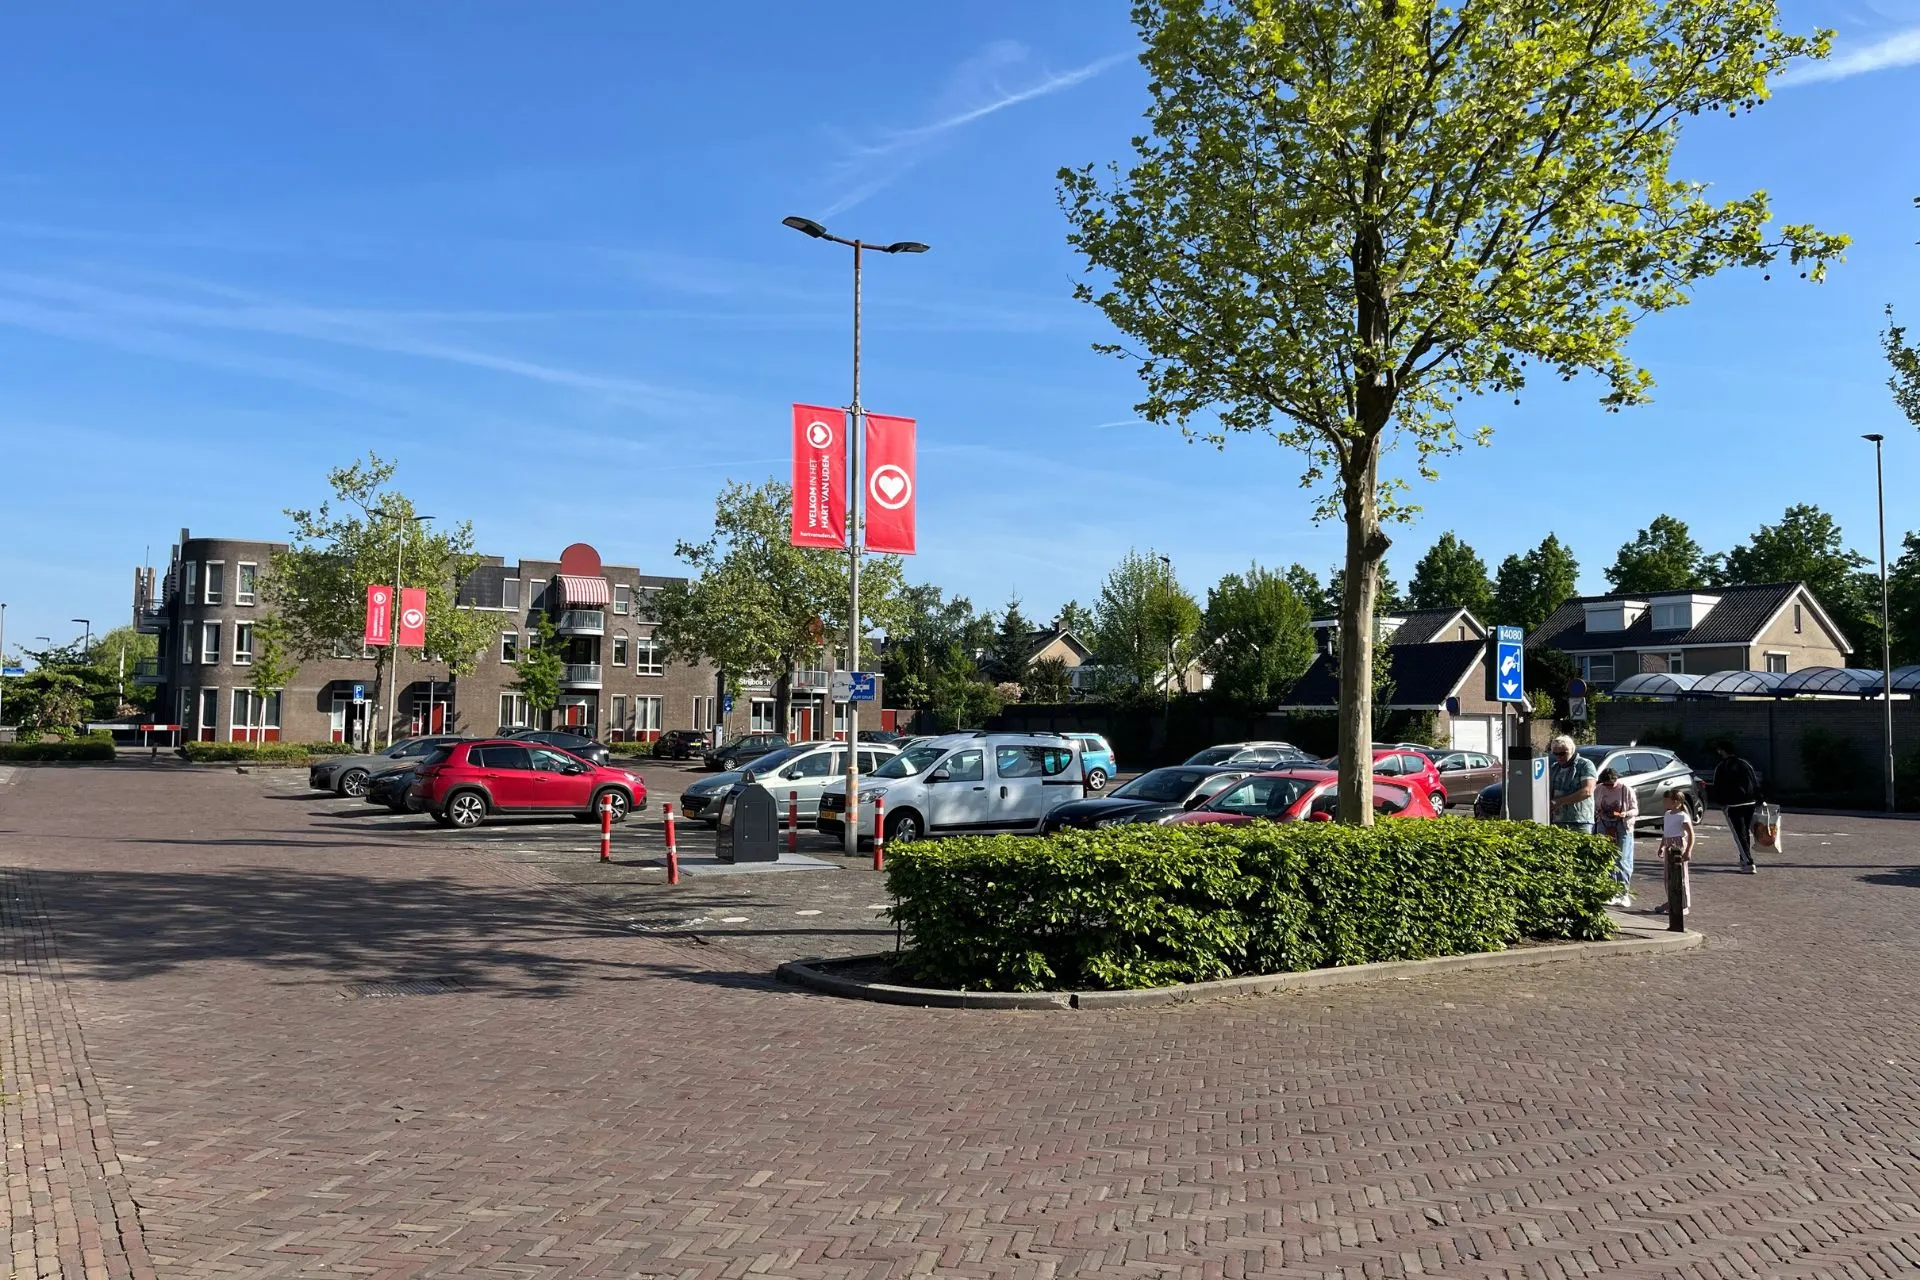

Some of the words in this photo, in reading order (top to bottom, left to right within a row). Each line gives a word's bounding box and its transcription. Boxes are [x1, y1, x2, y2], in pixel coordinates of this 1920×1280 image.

[809, 458, 818, 475] HET
[821, 455, 830, 482] UDEN
[809, 476, 817, 486] IN
[821, 482, 830, 503] VAN
[809, 487, 817, 528] WELKOM
[821, 504, 829, 529] HART
